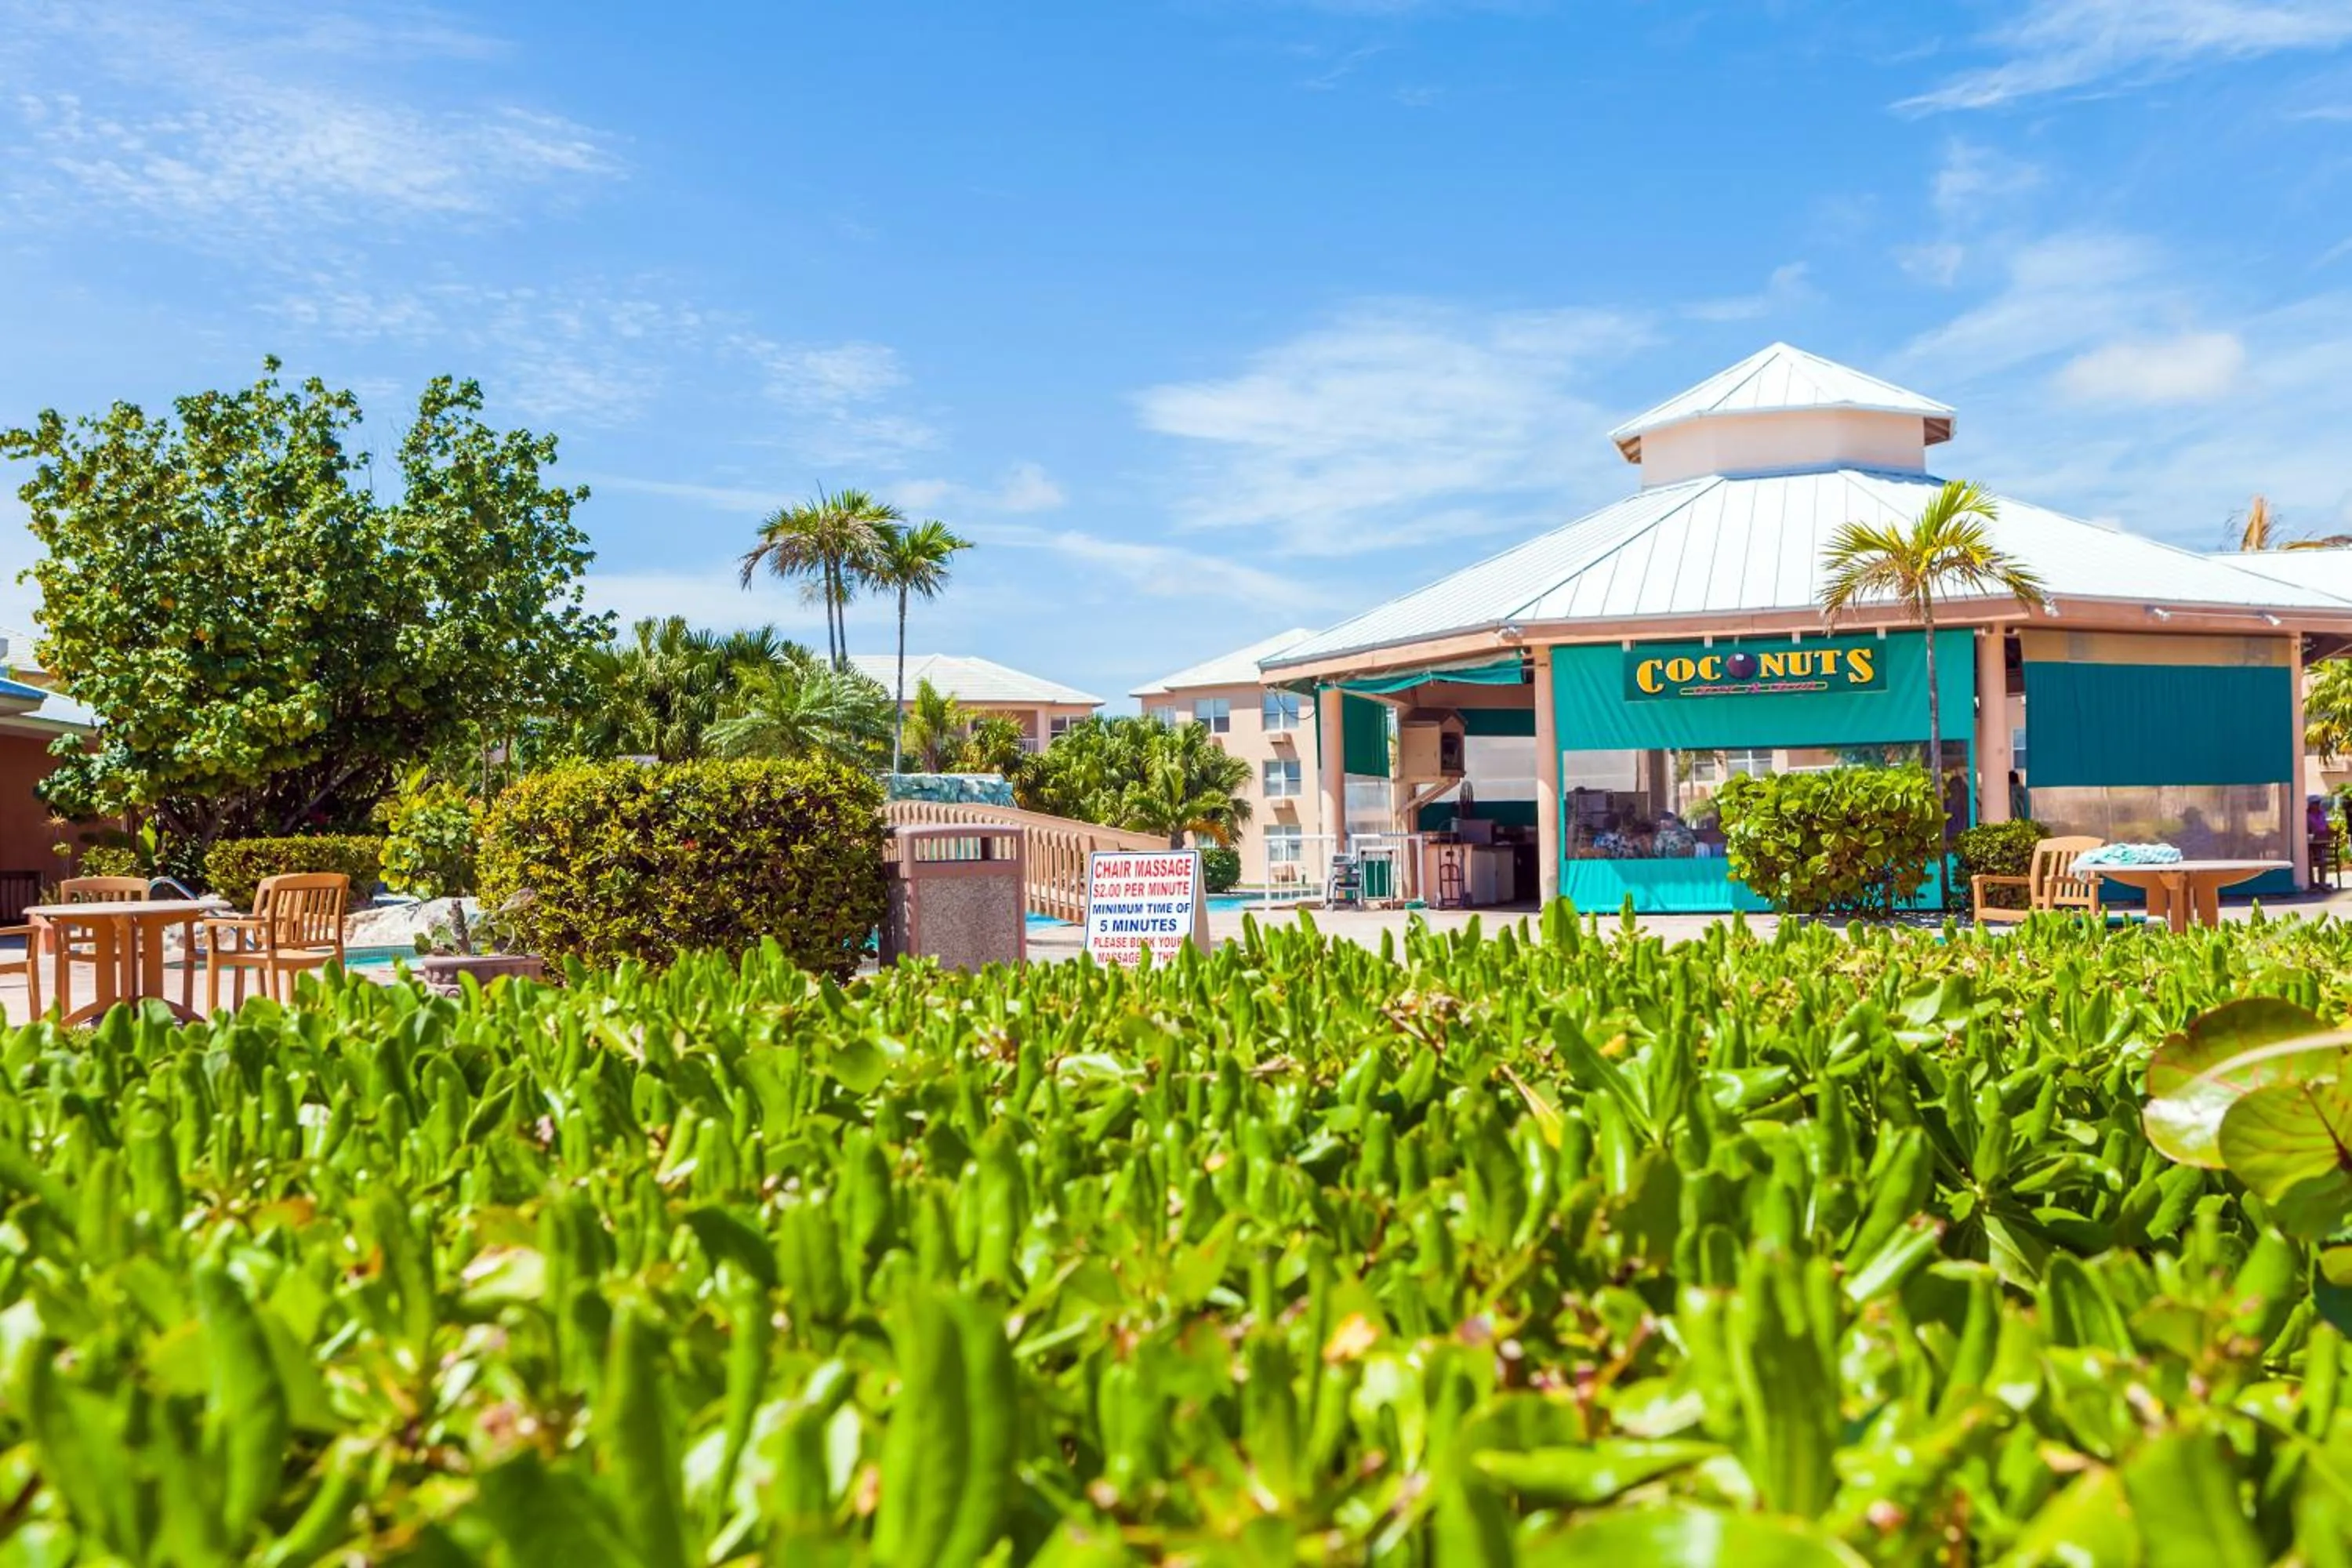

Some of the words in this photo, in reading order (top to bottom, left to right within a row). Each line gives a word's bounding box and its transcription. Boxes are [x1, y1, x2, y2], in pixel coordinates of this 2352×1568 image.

[1094, 861, 1131, 878] CHAIR
[1135, 859, 1192, 878] MASSAGE
[1093, 884, 1121, 898] $2.00
[1124, 883, 1145, 897] PER
[1148, 881, 1189, 896] MINUTE
[1093, 903, 1143, 914] MINIMUM
[1147, 903, 1173, 913] TIME
[1176, 902, 1191, 913] OF
[1100, 920, 1107, 932] 5
[1112, 919, 1177, 931] MINUTES
[1093, 937, 1127, 948] PLEASE
